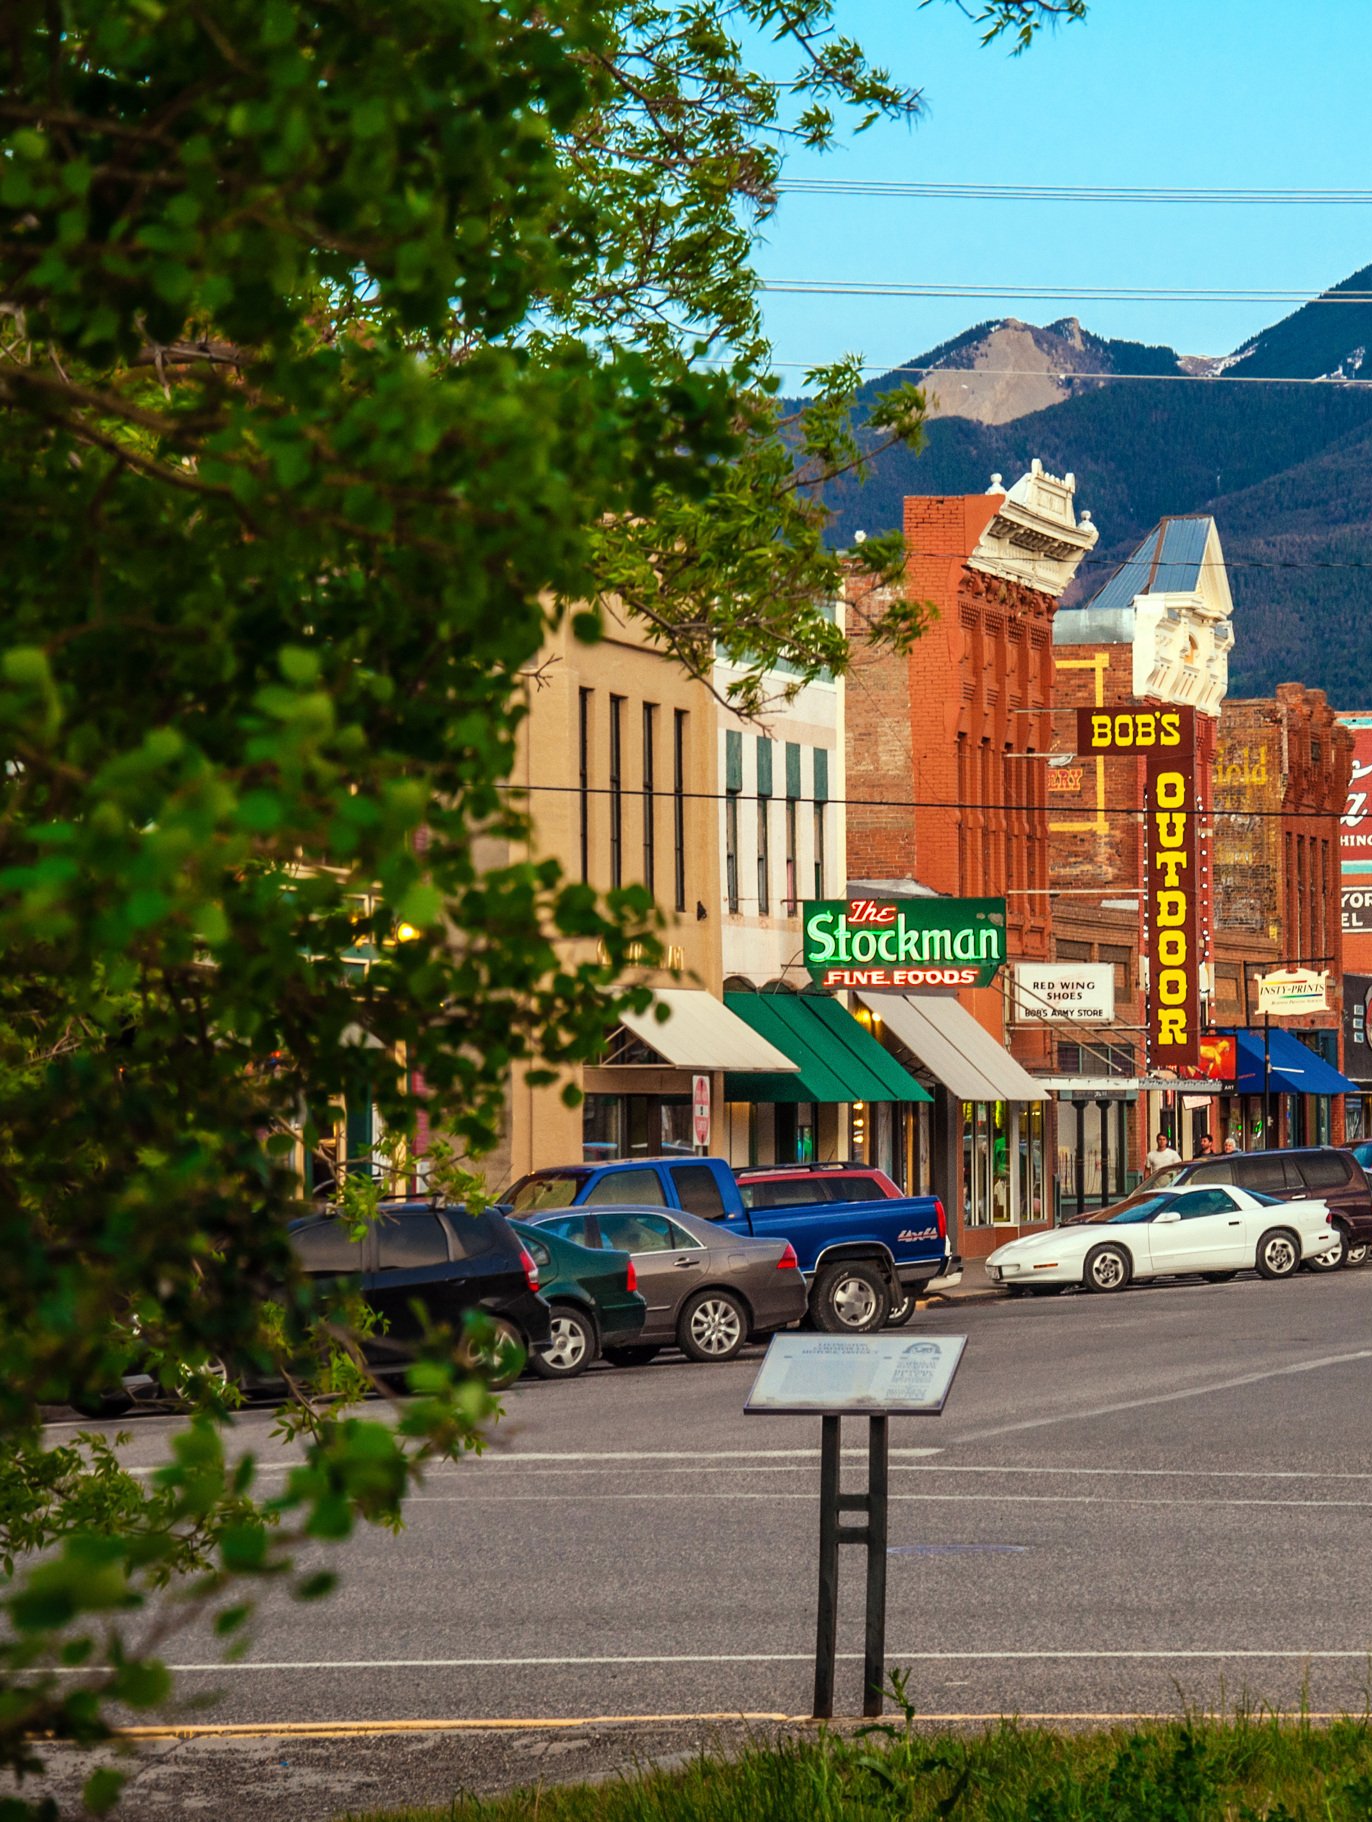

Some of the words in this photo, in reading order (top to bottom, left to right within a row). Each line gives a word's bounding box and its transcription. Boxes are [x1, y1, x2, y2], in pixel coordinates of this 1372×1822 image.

[1091, 711, 1181, 747] BOB'S
[1047, 768, 1083, 792] ERY
[848, 900, 897, 923] The
[1156, 771, 1188, 1045] OUTDOOR
[806, 910, 1001, 963] Stockman
[823, 971, 891, 985] FINE
[893, 970, 979, 985] FOODS
[1032, 981, 1055, 990] RED
[1060, 981, 1096, 990] WING
[1046, 991, 1083, 1000] SHOES
[1260, 983, 1325, 995] INSTY-PRINTS
[1024, 1008, 1048, 1018] BOB'S
[1050, 1008, 1075, 1018] ARMY
[1077, 1008, 1104, 1017] STORE
